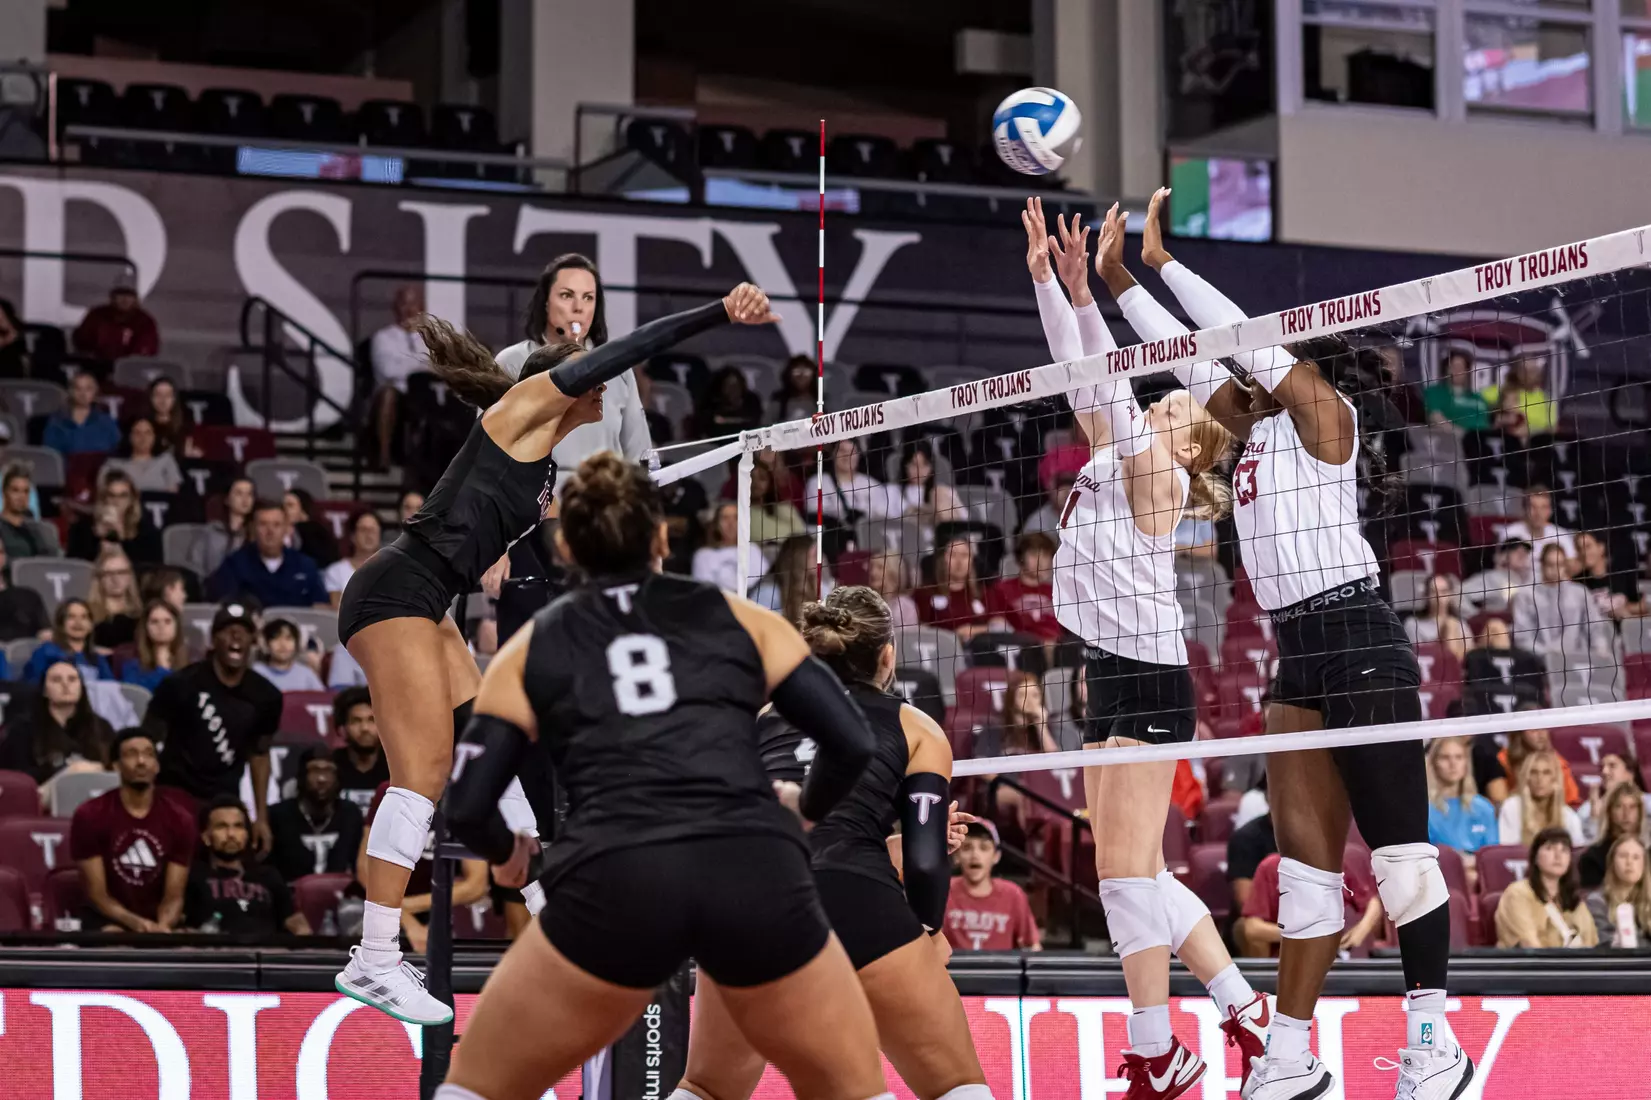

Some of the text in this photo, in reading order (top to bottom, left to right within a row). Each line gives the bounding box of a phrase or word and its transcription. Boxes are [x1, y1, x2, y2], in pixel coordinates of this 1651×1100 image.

[1475, 242, 1588, 293] TROY TROJANS
[1280, 290, 1381, 336] TROY TROJANS
[1106, 331, 1197, 374] TROY TROJANS
[951, 371, 1032, 409] TROY TROJANS
[839, 404, 884, 432] TROJANS
[1235, 460, 1260, 507] 23
[1272, 604, 1306, 624] NIKE
[1310, 585, 1355, 611] PRO
[606, 634, 677, 717] 8
[948, 908, 1010, 933] TROY
[643, 1003, 663, 1067] sports
